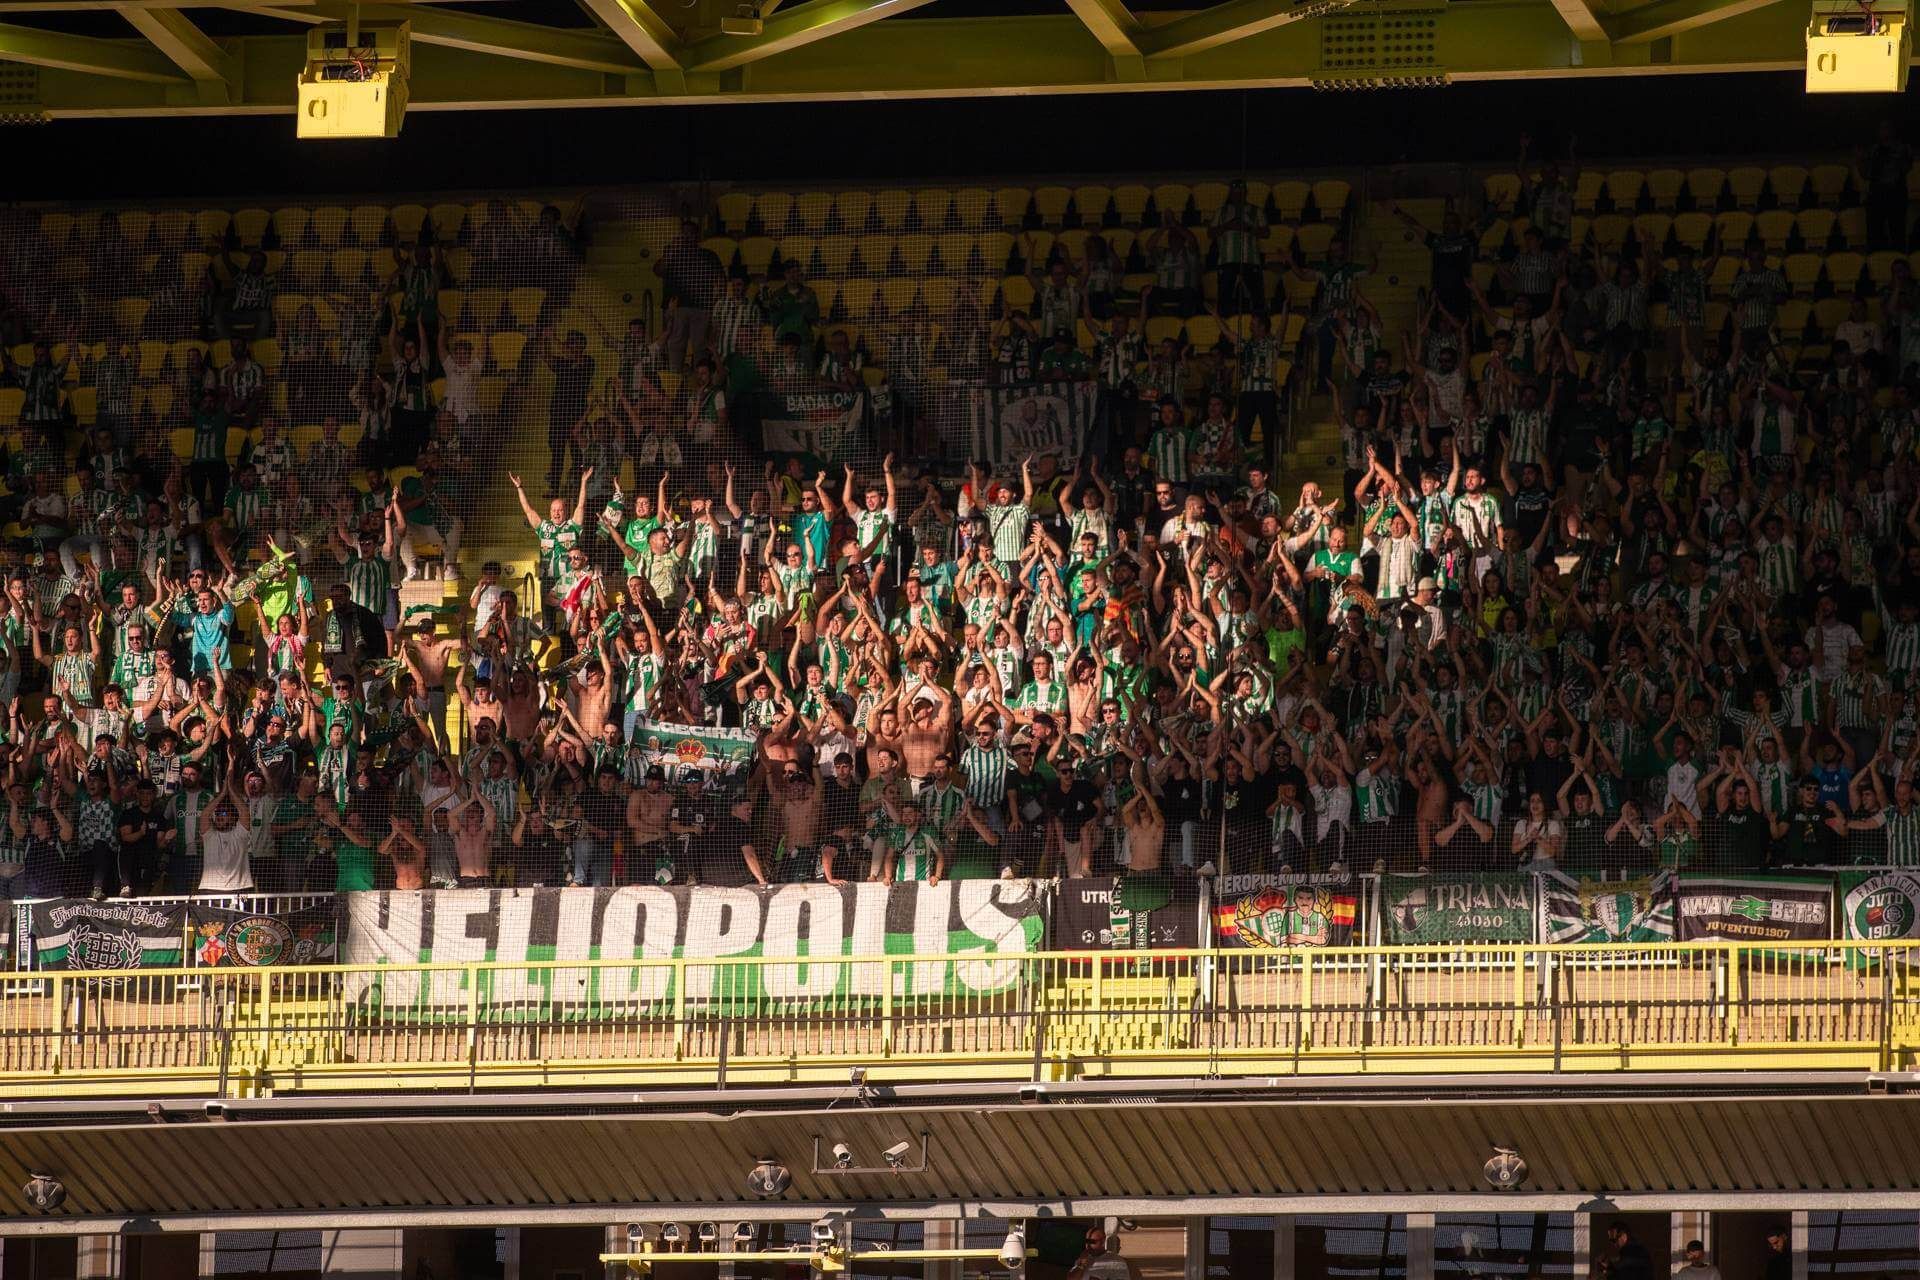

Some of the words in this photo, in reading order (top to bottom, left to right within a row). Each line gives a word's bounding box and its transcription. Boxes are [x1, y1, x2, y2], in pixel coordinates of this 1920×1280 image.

[1432, 883, 1530, 913] TRIANA
[1680, 896, 1736, 917] AWAY
[113, 906, 132, 921] del
[132, 906, 169, 928] Betis
[1867, 923, 1902, 940] 1907
[346, 881, 1043, 1006] HELIOPOLIS
